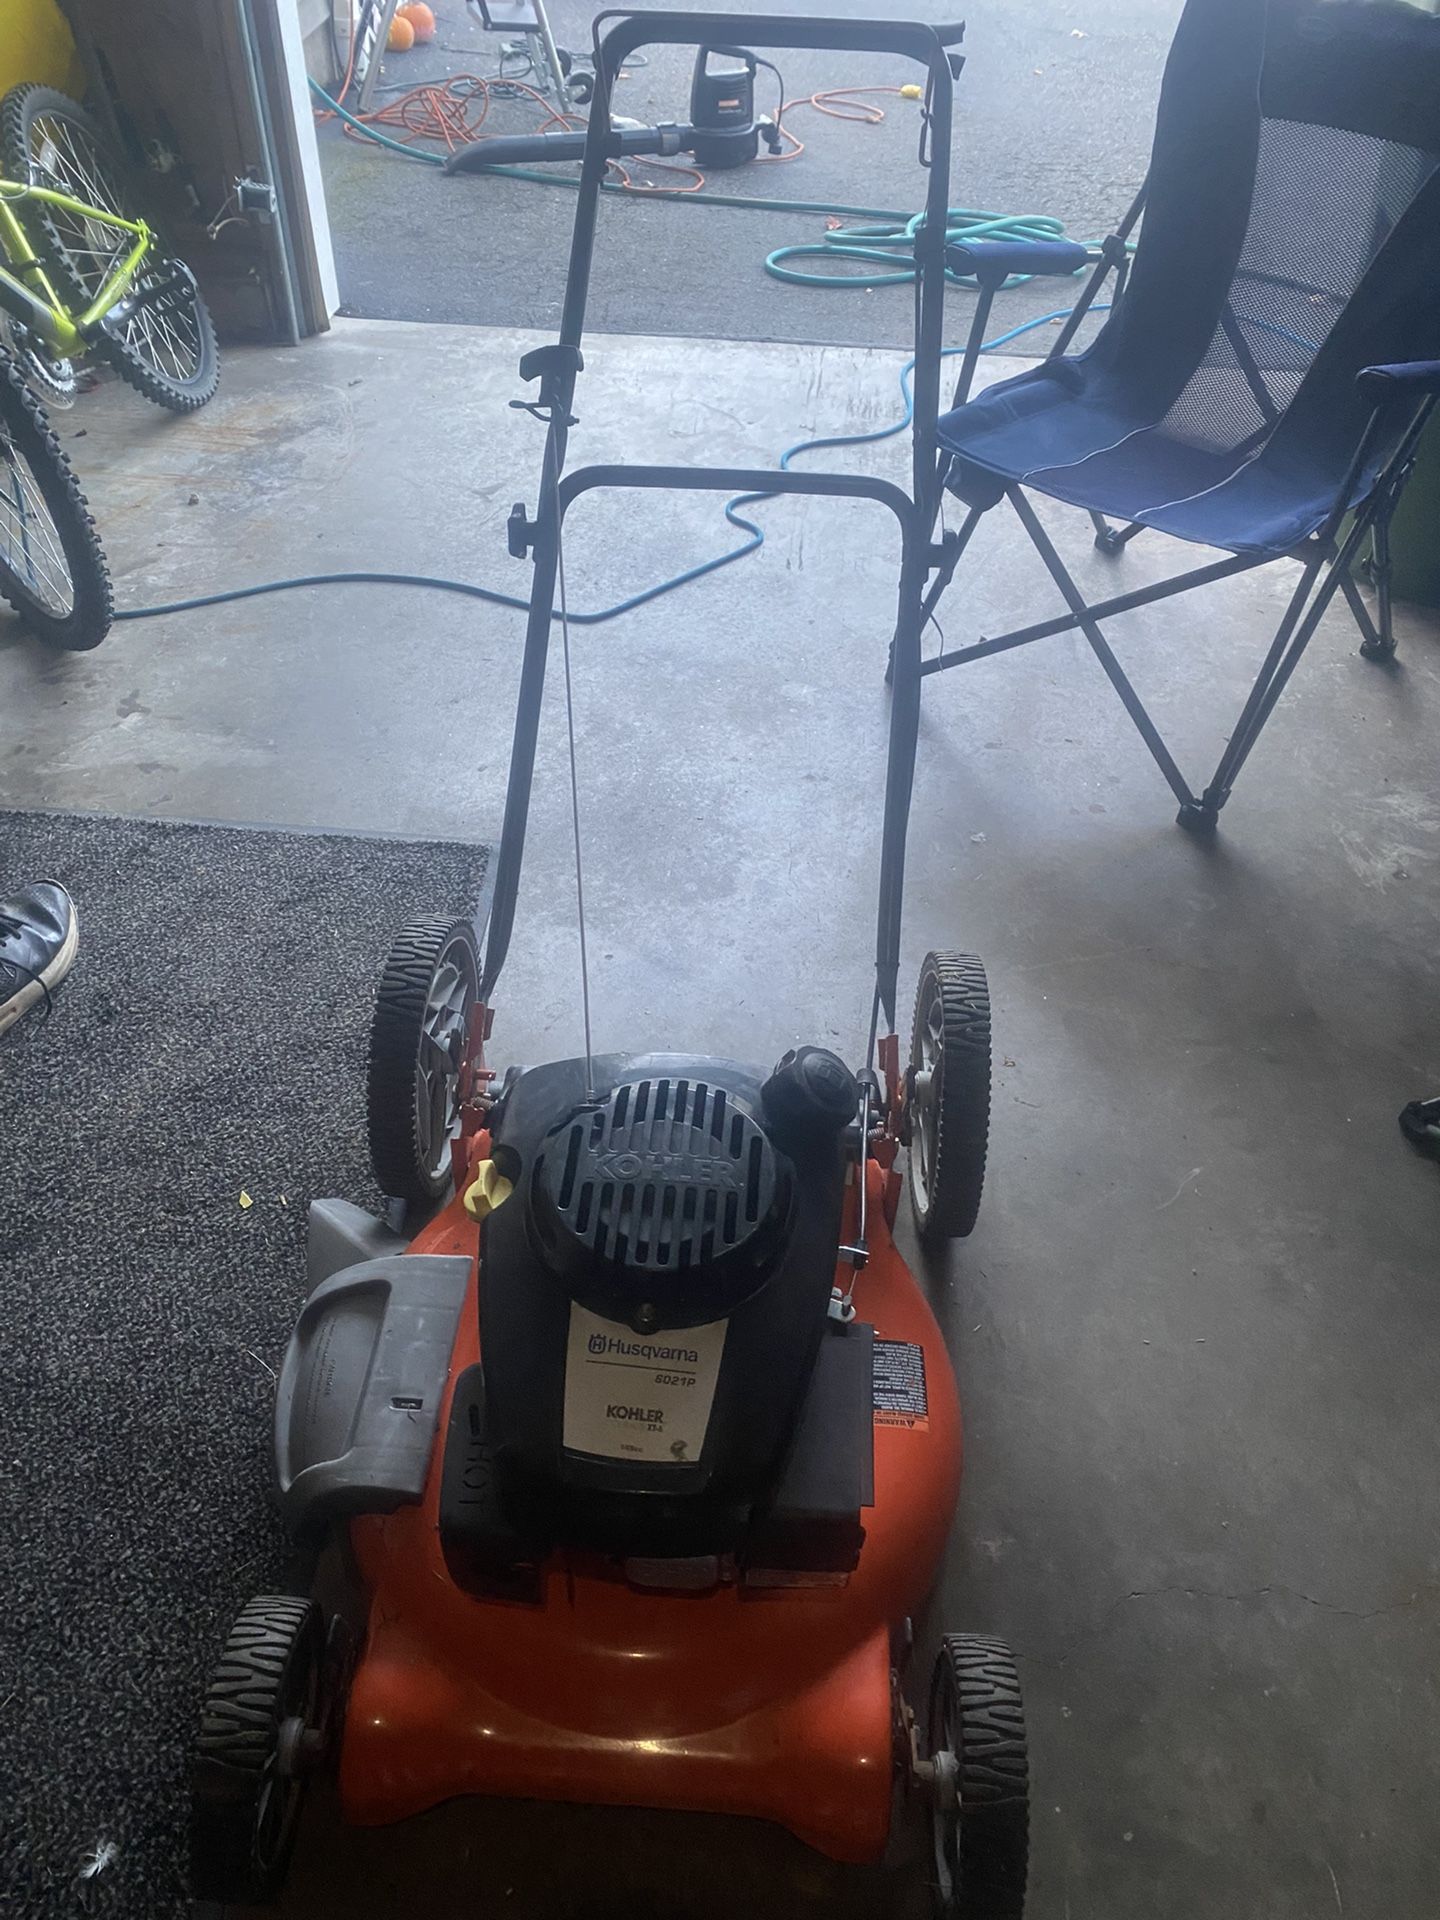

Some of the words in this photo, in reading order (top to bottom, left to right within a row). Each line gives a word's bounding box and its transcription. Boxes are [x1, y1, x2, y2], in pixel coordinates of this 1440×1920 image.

[586, 1152, 737, 1188] KOHLER
[607, 1338, 698, 1363] Husqvarna
[605, 1404, 664, 1423] KOHLER
